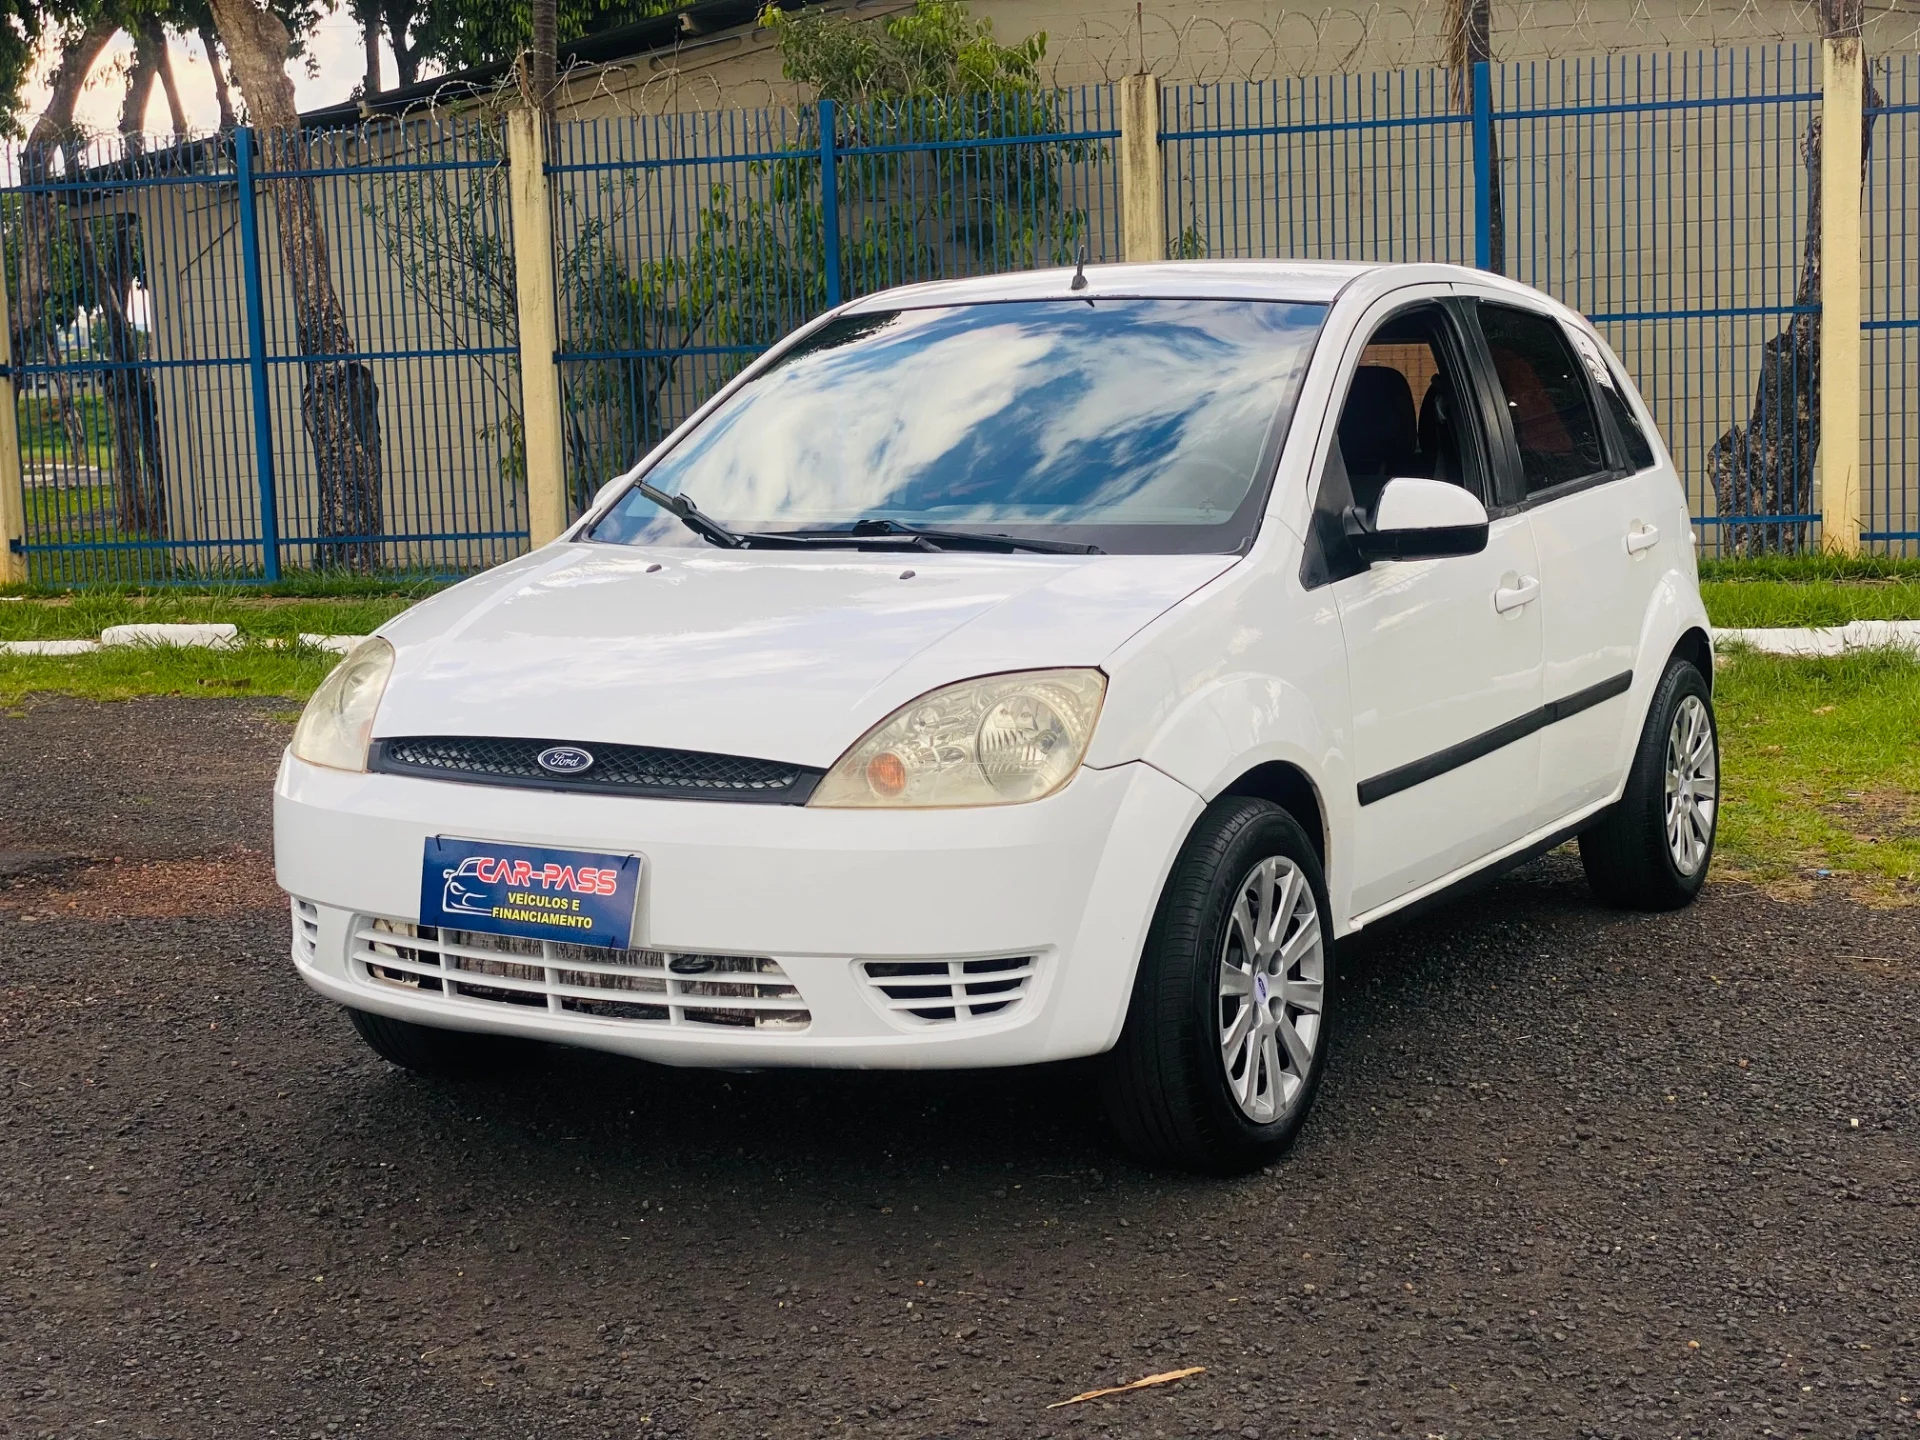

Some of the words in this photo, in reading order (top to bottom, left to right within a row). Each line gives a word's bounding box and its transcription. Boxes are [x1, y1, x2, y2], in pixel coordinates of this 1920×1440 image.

[550, 752, 579, 767] Ford
[477, 858, 617, 896] CAR-PASS
[508, 892, 568, 910] VEÍCULOS
[572, 900, 581, 911] E
[492, 907, 593, 929] FINANCIAMENTO
